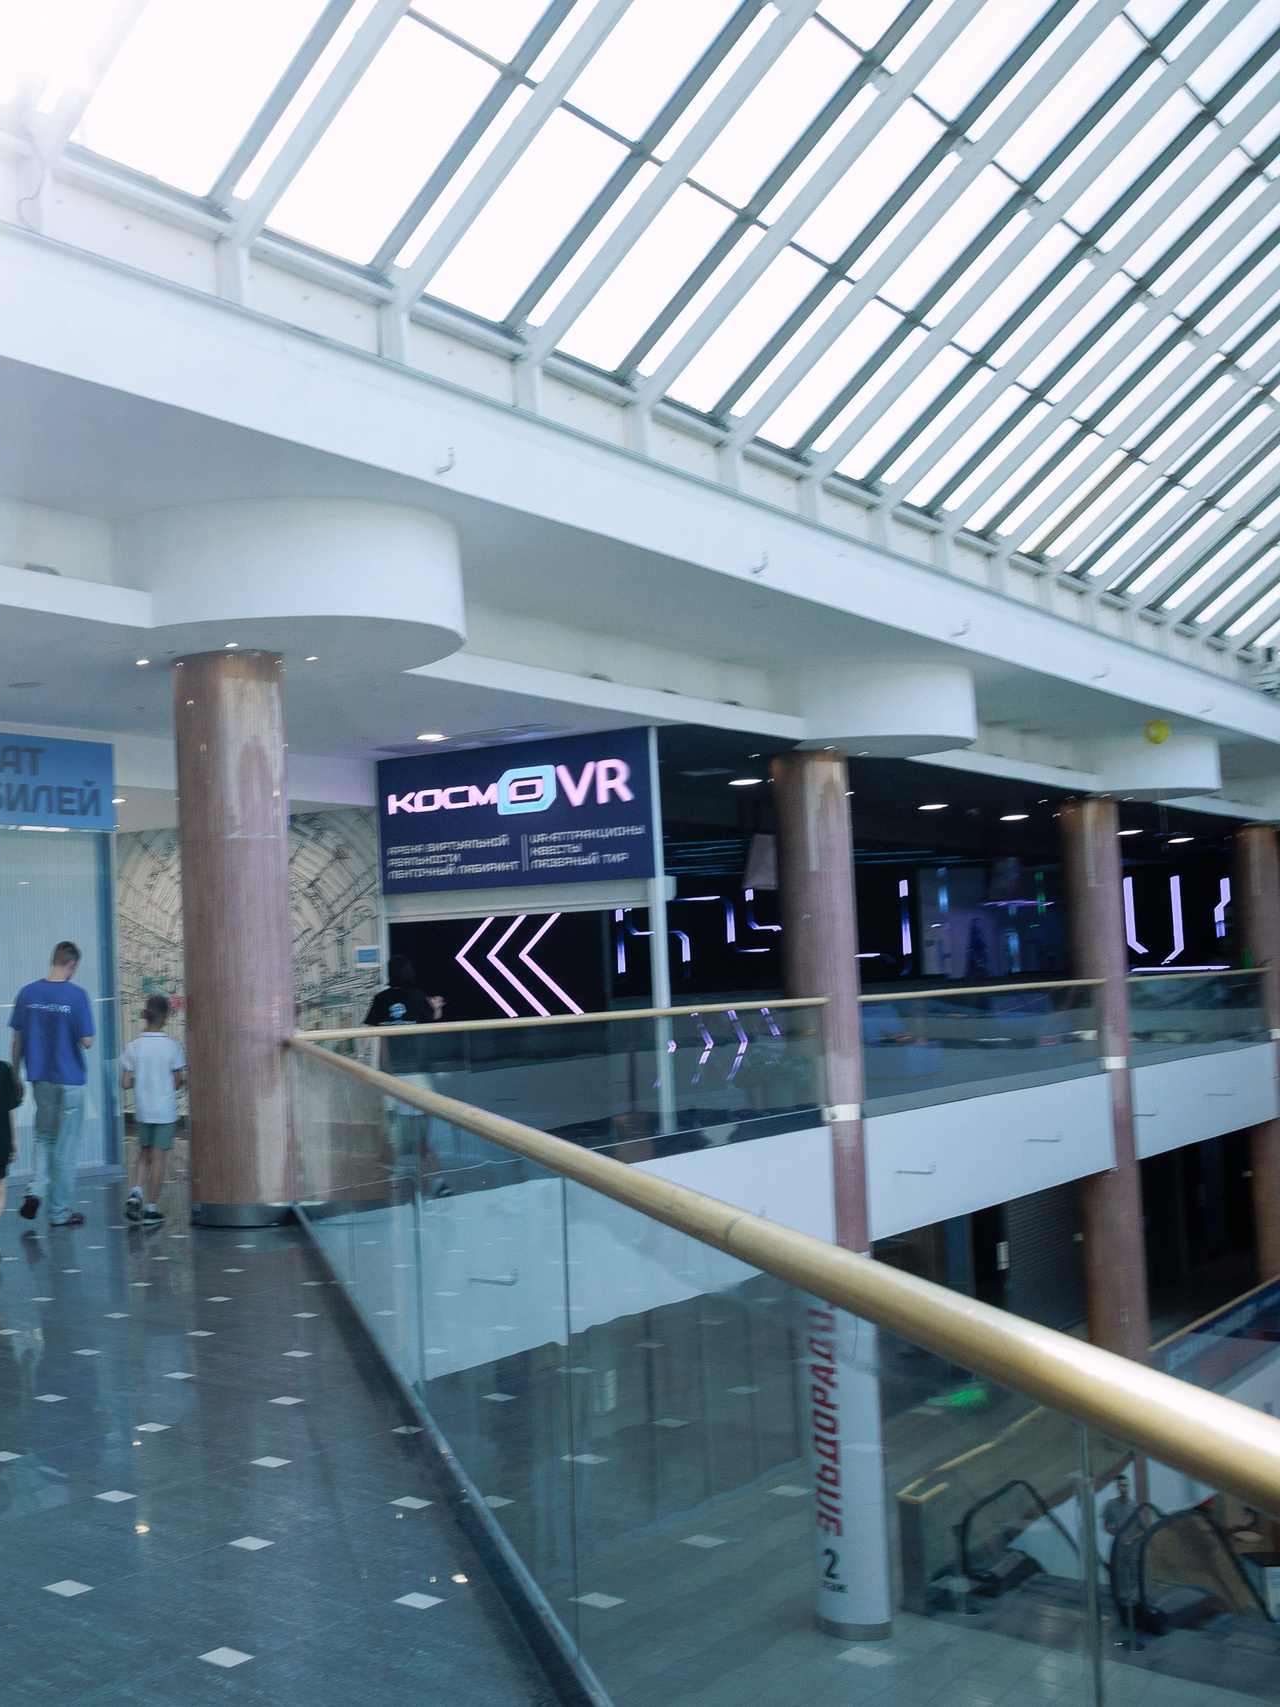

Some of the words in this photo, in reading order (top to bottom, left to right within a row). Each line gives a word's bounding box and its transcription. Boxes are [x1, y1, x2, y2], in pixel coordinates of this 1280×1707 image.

[387, 845, 424, 856] АРЕНА
[425, 834, 509, 853] ВИРТУАЛЬНОЙ
[530, 844, 582, 857] КВЕСТЫ
[387, 853, 461, 868] РЕАЛЬНОСТИ
[530, 852, 599, 870] ЛАЗЕРНЫЙ
[600, 853, 629, 865] ТИР
[387, 864, 456, 880] ЛЕНТОЧНЫЙ
[457, 861, 520, 875] ЛАБИРИНТ
[821, 1548, 840, 1579] 2
